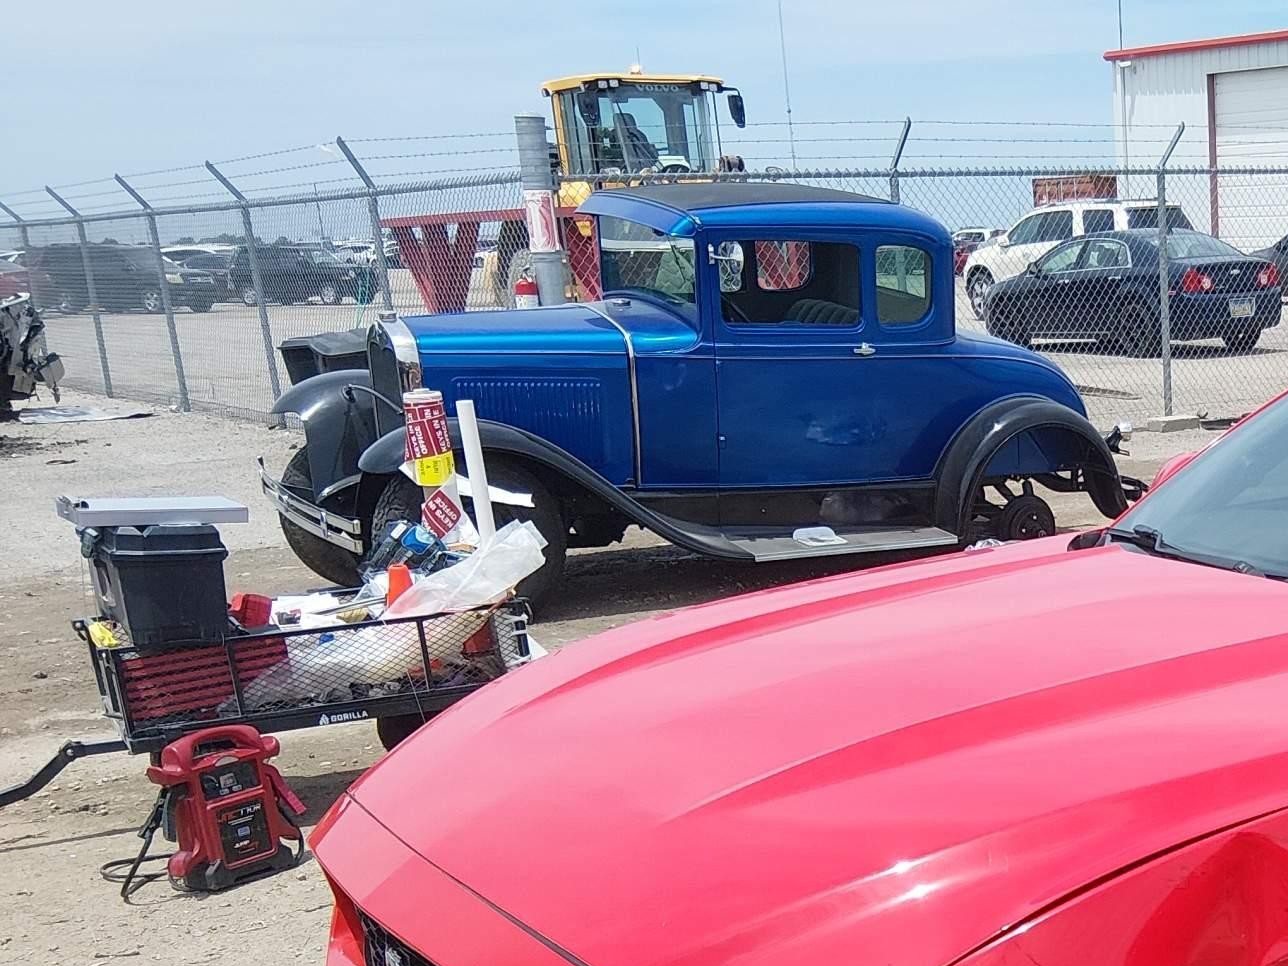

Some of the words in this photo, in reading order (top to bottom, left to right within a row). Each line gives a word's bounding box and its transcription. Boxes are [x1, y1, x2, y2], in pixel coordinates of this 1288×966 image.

[635, 84, 679, 92] VOLVO
[411, 435, 422, 458] KEYS
[414, 425, 428, 456] OFFICE
[436, 430, 448, 453] KEYS
[434, 509, 455, 529] KEYS
[435, 497, 457, 521] OFFICE
[330, 710, 369, 722] GORILLA
